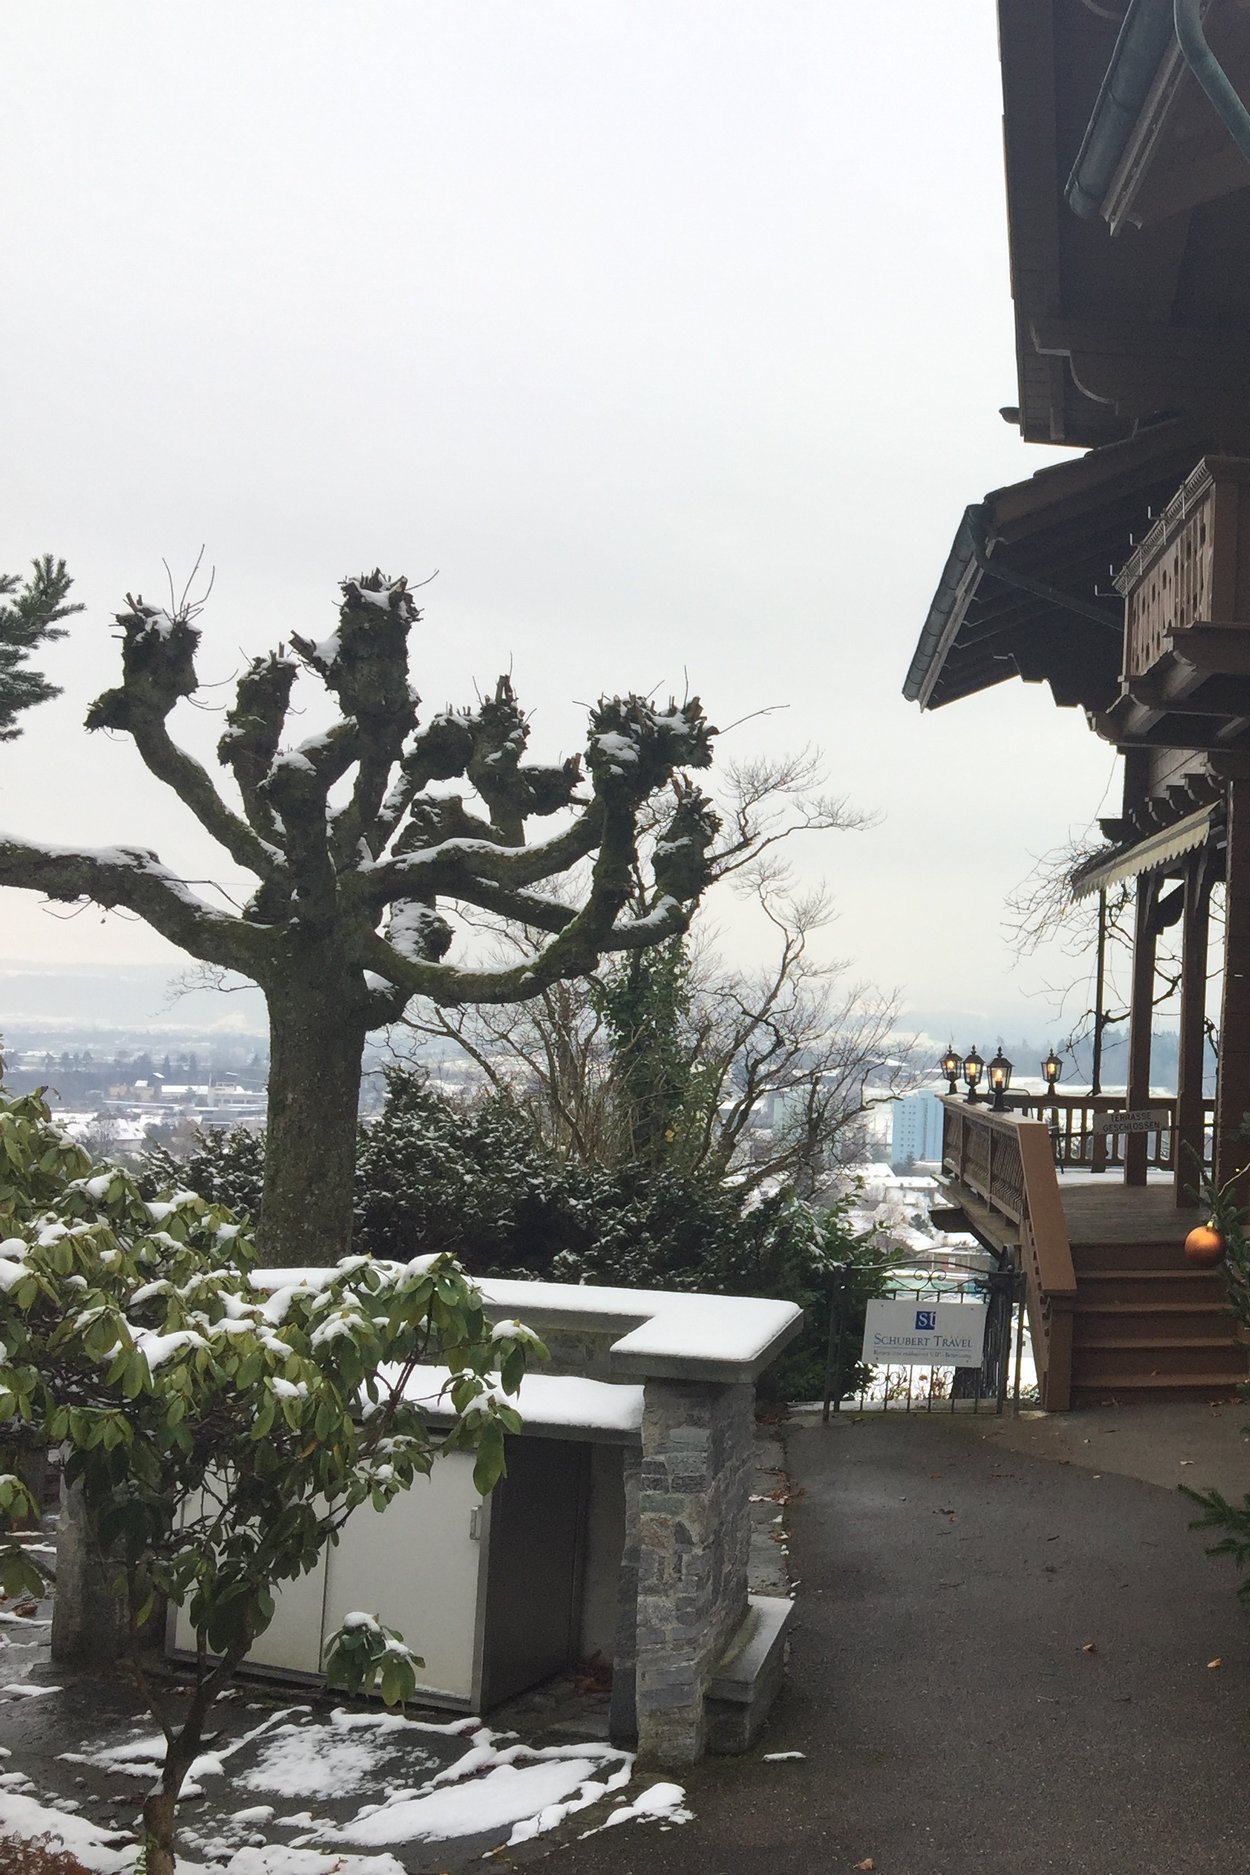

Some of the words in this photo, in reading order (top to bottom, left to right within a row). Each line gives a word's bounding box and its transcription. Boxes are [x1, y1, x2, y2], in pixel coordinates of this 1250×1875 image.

[1111, 1112, 1152, 1122] TERRASSE
[1102, 1120, 1160, 1133] GESCHLOSSEN
[873, 1332, 930, 1347] SCHUBERT
[933, 1335, 973, 1348] TRAVEL
